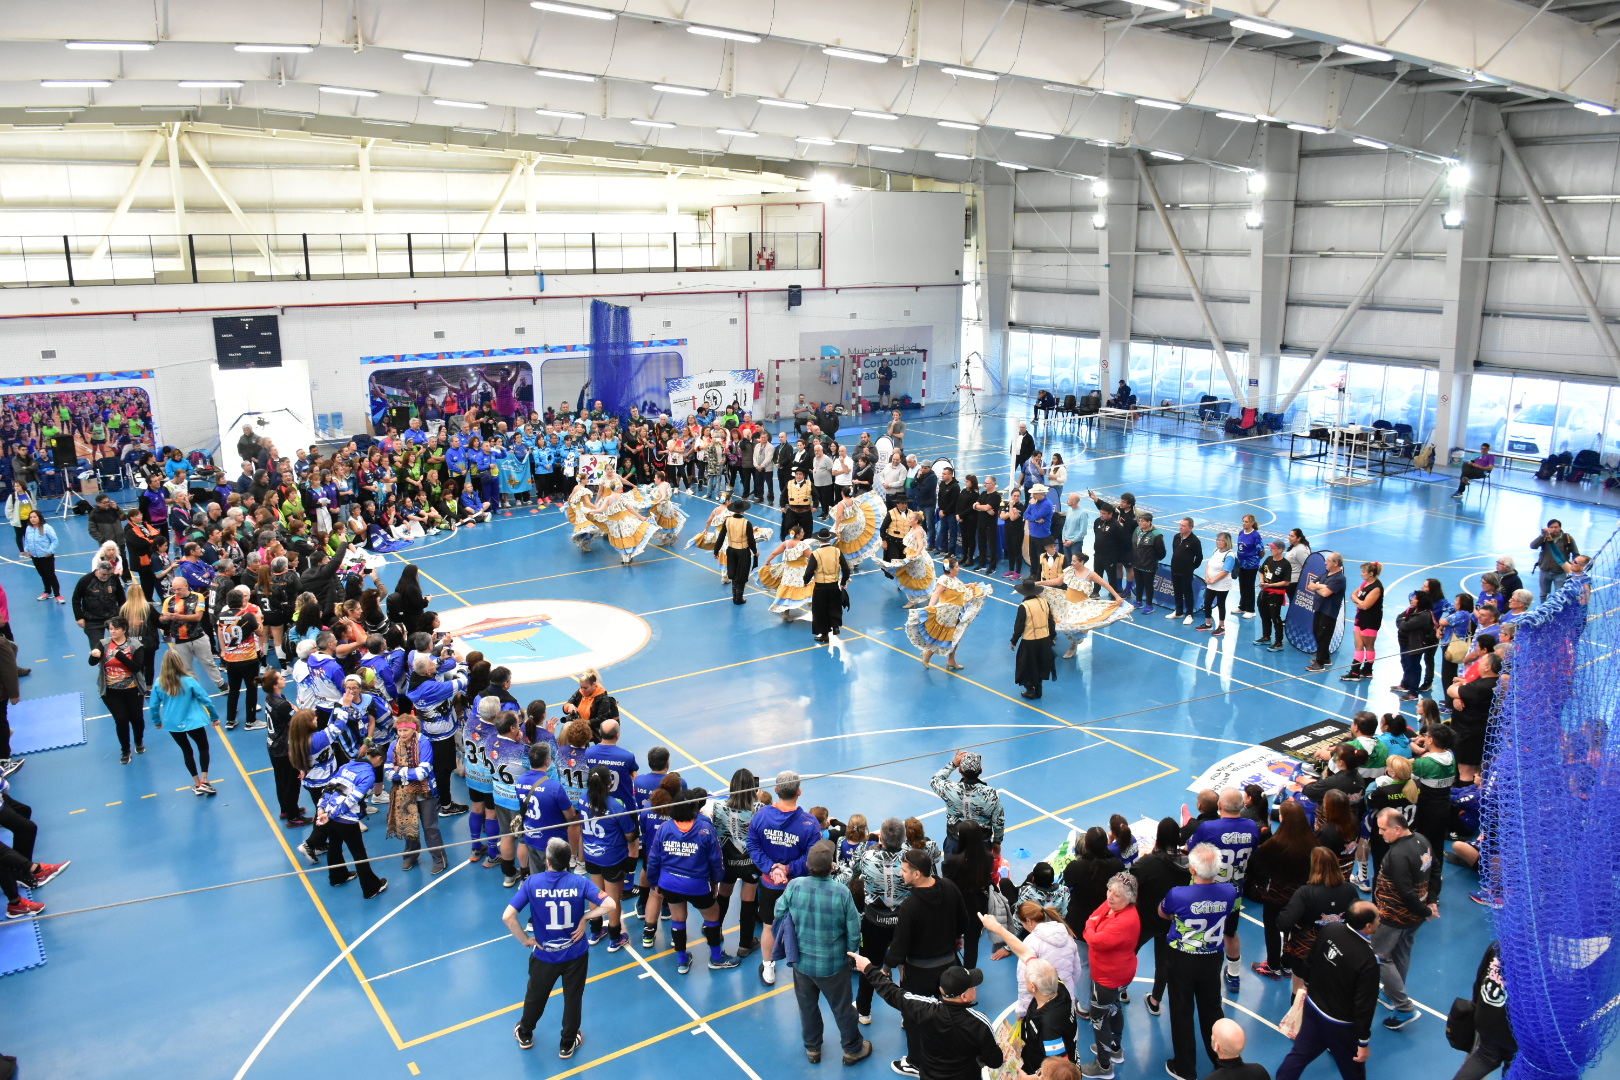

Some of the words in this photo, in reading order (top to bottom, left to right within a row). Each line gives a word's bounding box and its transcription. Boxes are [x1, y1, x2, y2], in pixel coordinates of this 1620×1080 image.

[598, 759, 625, 767] ANDINOS
[563, 768, 584, 789] 11
[763, 828, 784, 837] CALETA
[662, 840, 681, 848] CALETA
[681, 841, 699, 850] OLIVIA
[535, 888, 578, 898] EPUYEN
[545, 900, 575, 930] 11
[1181, 915, 1227, 947] 24
